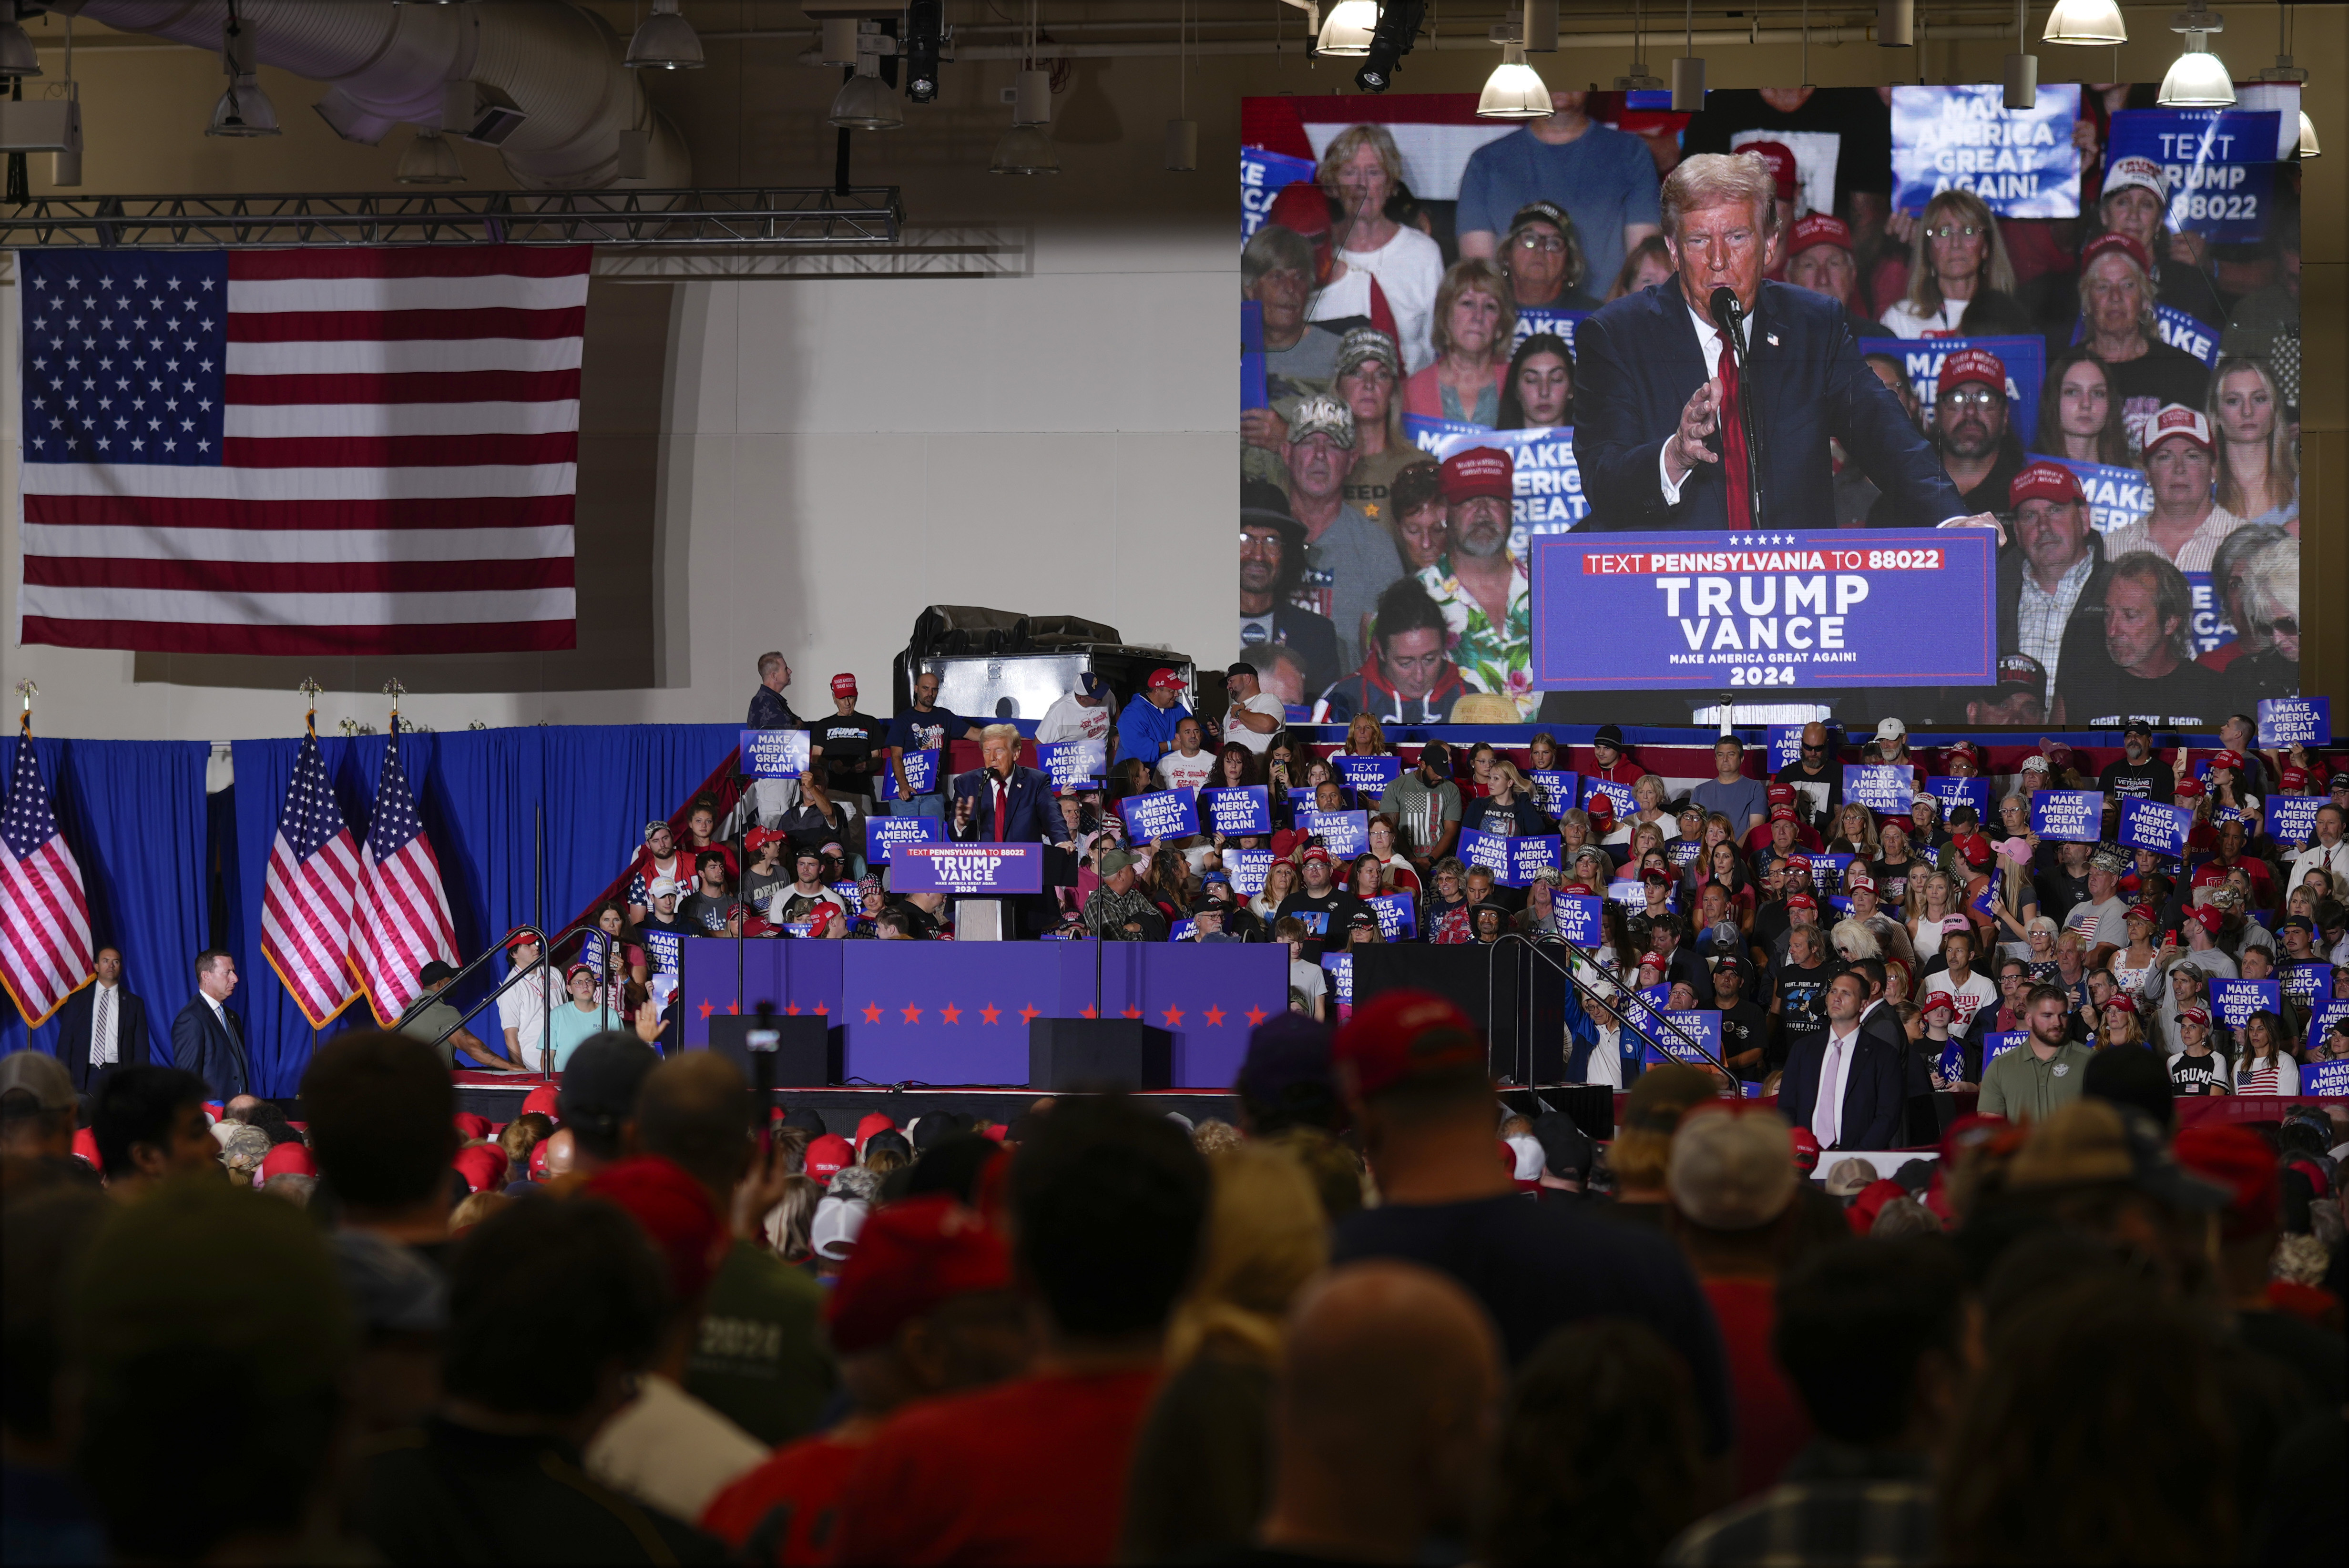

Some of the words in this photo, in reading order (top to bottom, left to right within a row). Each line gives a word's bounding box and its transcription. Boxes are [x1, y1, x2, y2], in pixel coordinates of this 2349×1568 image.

[1919, 122, 2054, 147] AMERICA
[2158, 133, 2236, 161] TEXT
[1934, 149, 2037, 173] GREAT
[2167, 165, 2246, 191] RUMP
[1514, 319, 1574, 336] AKE
[1511, 495, 1584, 523] REAT
[1588, 555, 1643, 573] TEXT
[1651, 552, 1825, 572] PENNSYLVANIA
[1832, 552, 1861, 570] TO
[1868, 551, 1939, 569] 88022
[1656, 575, 1869, 616] TRUMP
[1681, 617, 1844, 650] VANCE
[1670, 654, 1704, 663] MAKE
[1708, 654, 1764, 663] AMERICA
[1769, 653, 1809, 663] GREAT
[1813, 652, 1856, 662] AGAIN!
[1730, 667, 1795, 685] 2024
[2276, 703, 2309, 713] MAKE
[2267, 713, 2320, 723] AMERICA
[827, 727, 860, 736] TRUMP
[2274, 722, 2314, 732] GREAT
[758, 735, 790, 744] MAKE
[2274, 731, 2315, 742] AGAIN!
[748, 744, 799, 753] AMERICA
[1053, 745, 1085, 756] MAKE
[755, 753, 793, 763] GREAT
[1045, 754, 1095, 766] AMERICA
[755, 763, 794, 773] AGAIN!
[1052, 764, 1089, 775] GREAT
[1351, 764, 1380, 772] TEXT
[1052, 774, 1091, 784] AGAIN!
[1345, 774, 1385, 782] TRUMP
[1861, 770, 1895, 779] MAKE
[1852, 779, 1904, 789] AMERICA
[1596, 784, 1631, 797] MAKE
[1859, 789, 1897, 798] GREAT
[1941, 785, 1970, 795] TEXT
[1142, 794, 1176, 807] MAKE
[1217, 791, 1249, 801] MAKE
[1532, 794, 1560, 803] REAT
[2050, 795, 2083, 805] MAKE
[1210, 800, 1259, 812] AMERICA
[1859, 798, 1898, 808] AGAIN!
[2285, 801, 2318, 810] MAKE
[1134, 802, 1187, 820] AMERICA
[1215, 810, 1252, 820] GREAT
[2039, 804, 2092, 815] AMERICA
[2140, 804, 2173, 820] MAKE
[2274, 810, 2317, 820] AMERIC
[885, 821, 919, 830] MAKE
[1143, 813, 1181, 827] GREAT
[1215, 819, 1256, 831] AGAIN!
[1314, 816, 1348, 827] MAKE
[2045, 815, 2085, 825] GREAT
[2129, 811, 2180, 832] AMERICA
[876, 830, 929, 840] AMERICA
[1144, 822, 1185, 837] AGAIN!
[2043, 824, 2085, 835] AGAIN!
[2135, 822, 2172, 839] GREAT
[1313, 835, 1351, 845] GREAT
[2132, 832, 2171, 849] AGAIN!
[1466, 843, 1508, 860] AMERIC
[1520, 841, 1546, 851] MAKE
[1242, 853, 1275, 863] MAKE
[1513, 850, 1553, 861] AMERICA
[931, 857, 1001, 870] TRUMP
[1232, 863, 1271, 874] AMERIC
[1518, 860, 1549, 870] GREAT
[939, 870, 993, 881] VANCE
[1239, 873, 1266, 883] GREA
[1812, 879, 1839, 887] REAT
[1370, 900, 1394, 911] AKE
[1556, 896, 1582, 910] MAKE
[2278, 968, 2312, 978] MAKE
[2280, 977, 2322, 988] MERICA
[2226, 984, 2258, 995] MAKE
[2217, 994, 2269, 1005] AMERICA
[1666, 1015, 1701, 1025] MAKE
[2311, 1075, 2349, 1089] AMERI
[816, 1163, 840, 1171] TRUMP
